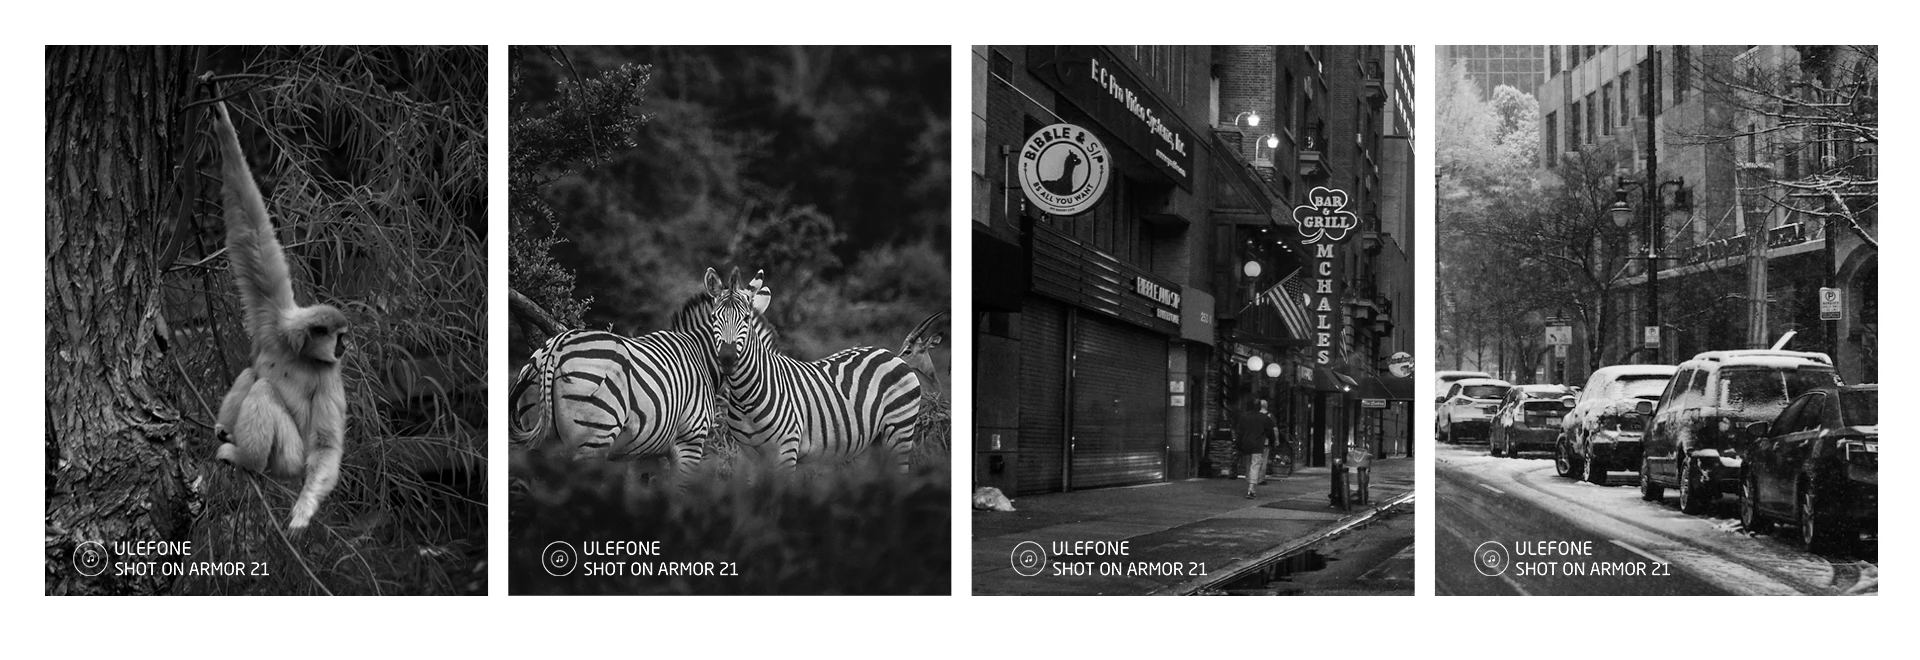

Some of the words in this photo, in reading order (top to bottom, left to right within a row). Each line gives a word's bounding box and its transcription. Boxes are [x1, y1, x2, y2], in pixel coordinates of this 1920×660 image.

[1091, 58, 1099, 82] E
[1101, 67, 1108, 89] C
[1109, 74, 1124, 103] Pro
[1125, 88, 1146, 121] Video
[1024, 127, 1071, 161] BIBBLE
[1075, 131, 1086, 145] &
[1086, 142, 1104, 164] SIP
[1040, 191, 1054, 202] ALL
[1073, 183, 1094, 202] WANT
[1314, 196, 1343, 207] BAR
[1322, 207, 1330, 215] &
[1303, 216, 1350, 228] GRILL
[1316, 243, 1334, 365] MCHALES
